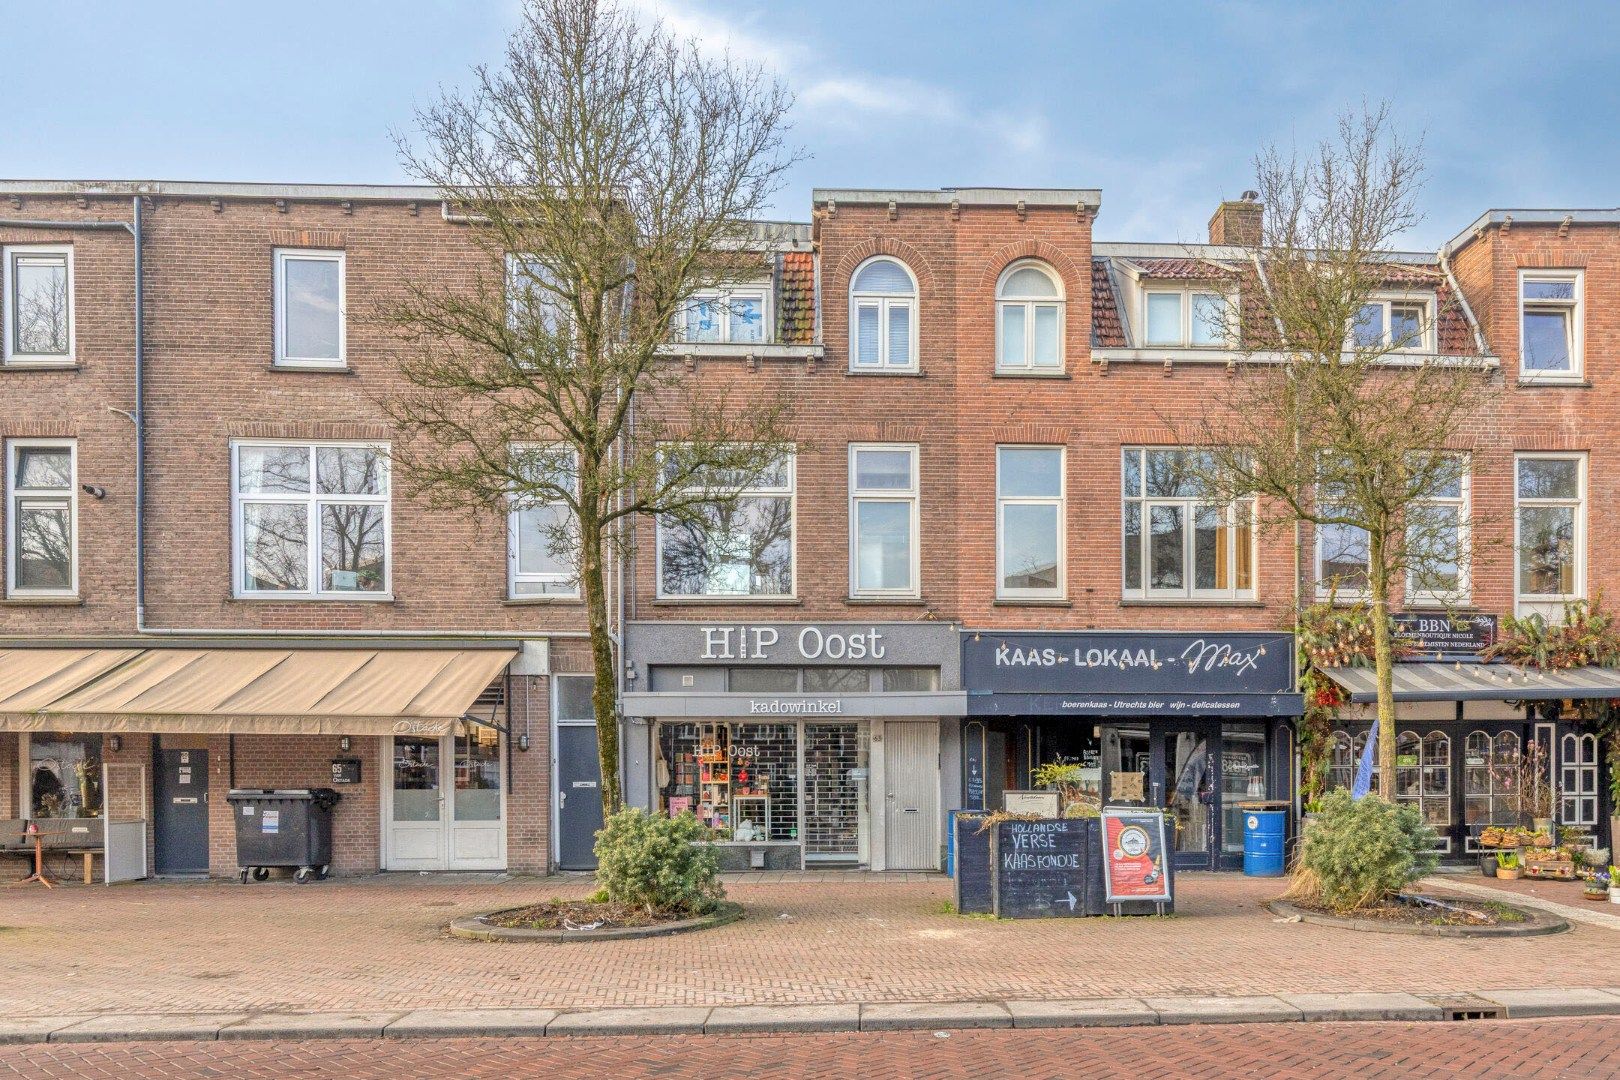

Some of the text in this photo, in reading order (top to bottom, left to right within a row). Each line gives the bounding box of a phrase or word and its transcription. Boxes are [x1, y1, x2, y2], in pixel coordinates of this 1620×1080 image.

[1419, 620, 1450, 632] BBN
[701, 626, 885, 660] HIP Oost
[1181, 639, 1261, 676] Max
[750, 700, 842, 714] kadowinkel
[1062, 701, 1108, 709] boerenkaas
[1113, 701, 1147, 709] Utrechts
[1148, 701, 1164, 709] bier
[1170, 701, 1185, 711] wijn
[1191, 701, 1240, 709] delicatessen
[393, 720, 447, 734] Ostade
[728, 745, 760, 757] Oost
[332, 763, 342, 774] 65
[1011, 823, 1068, 833] HOLLANDSE
[1011, 833, 1056, 849] VERSE
